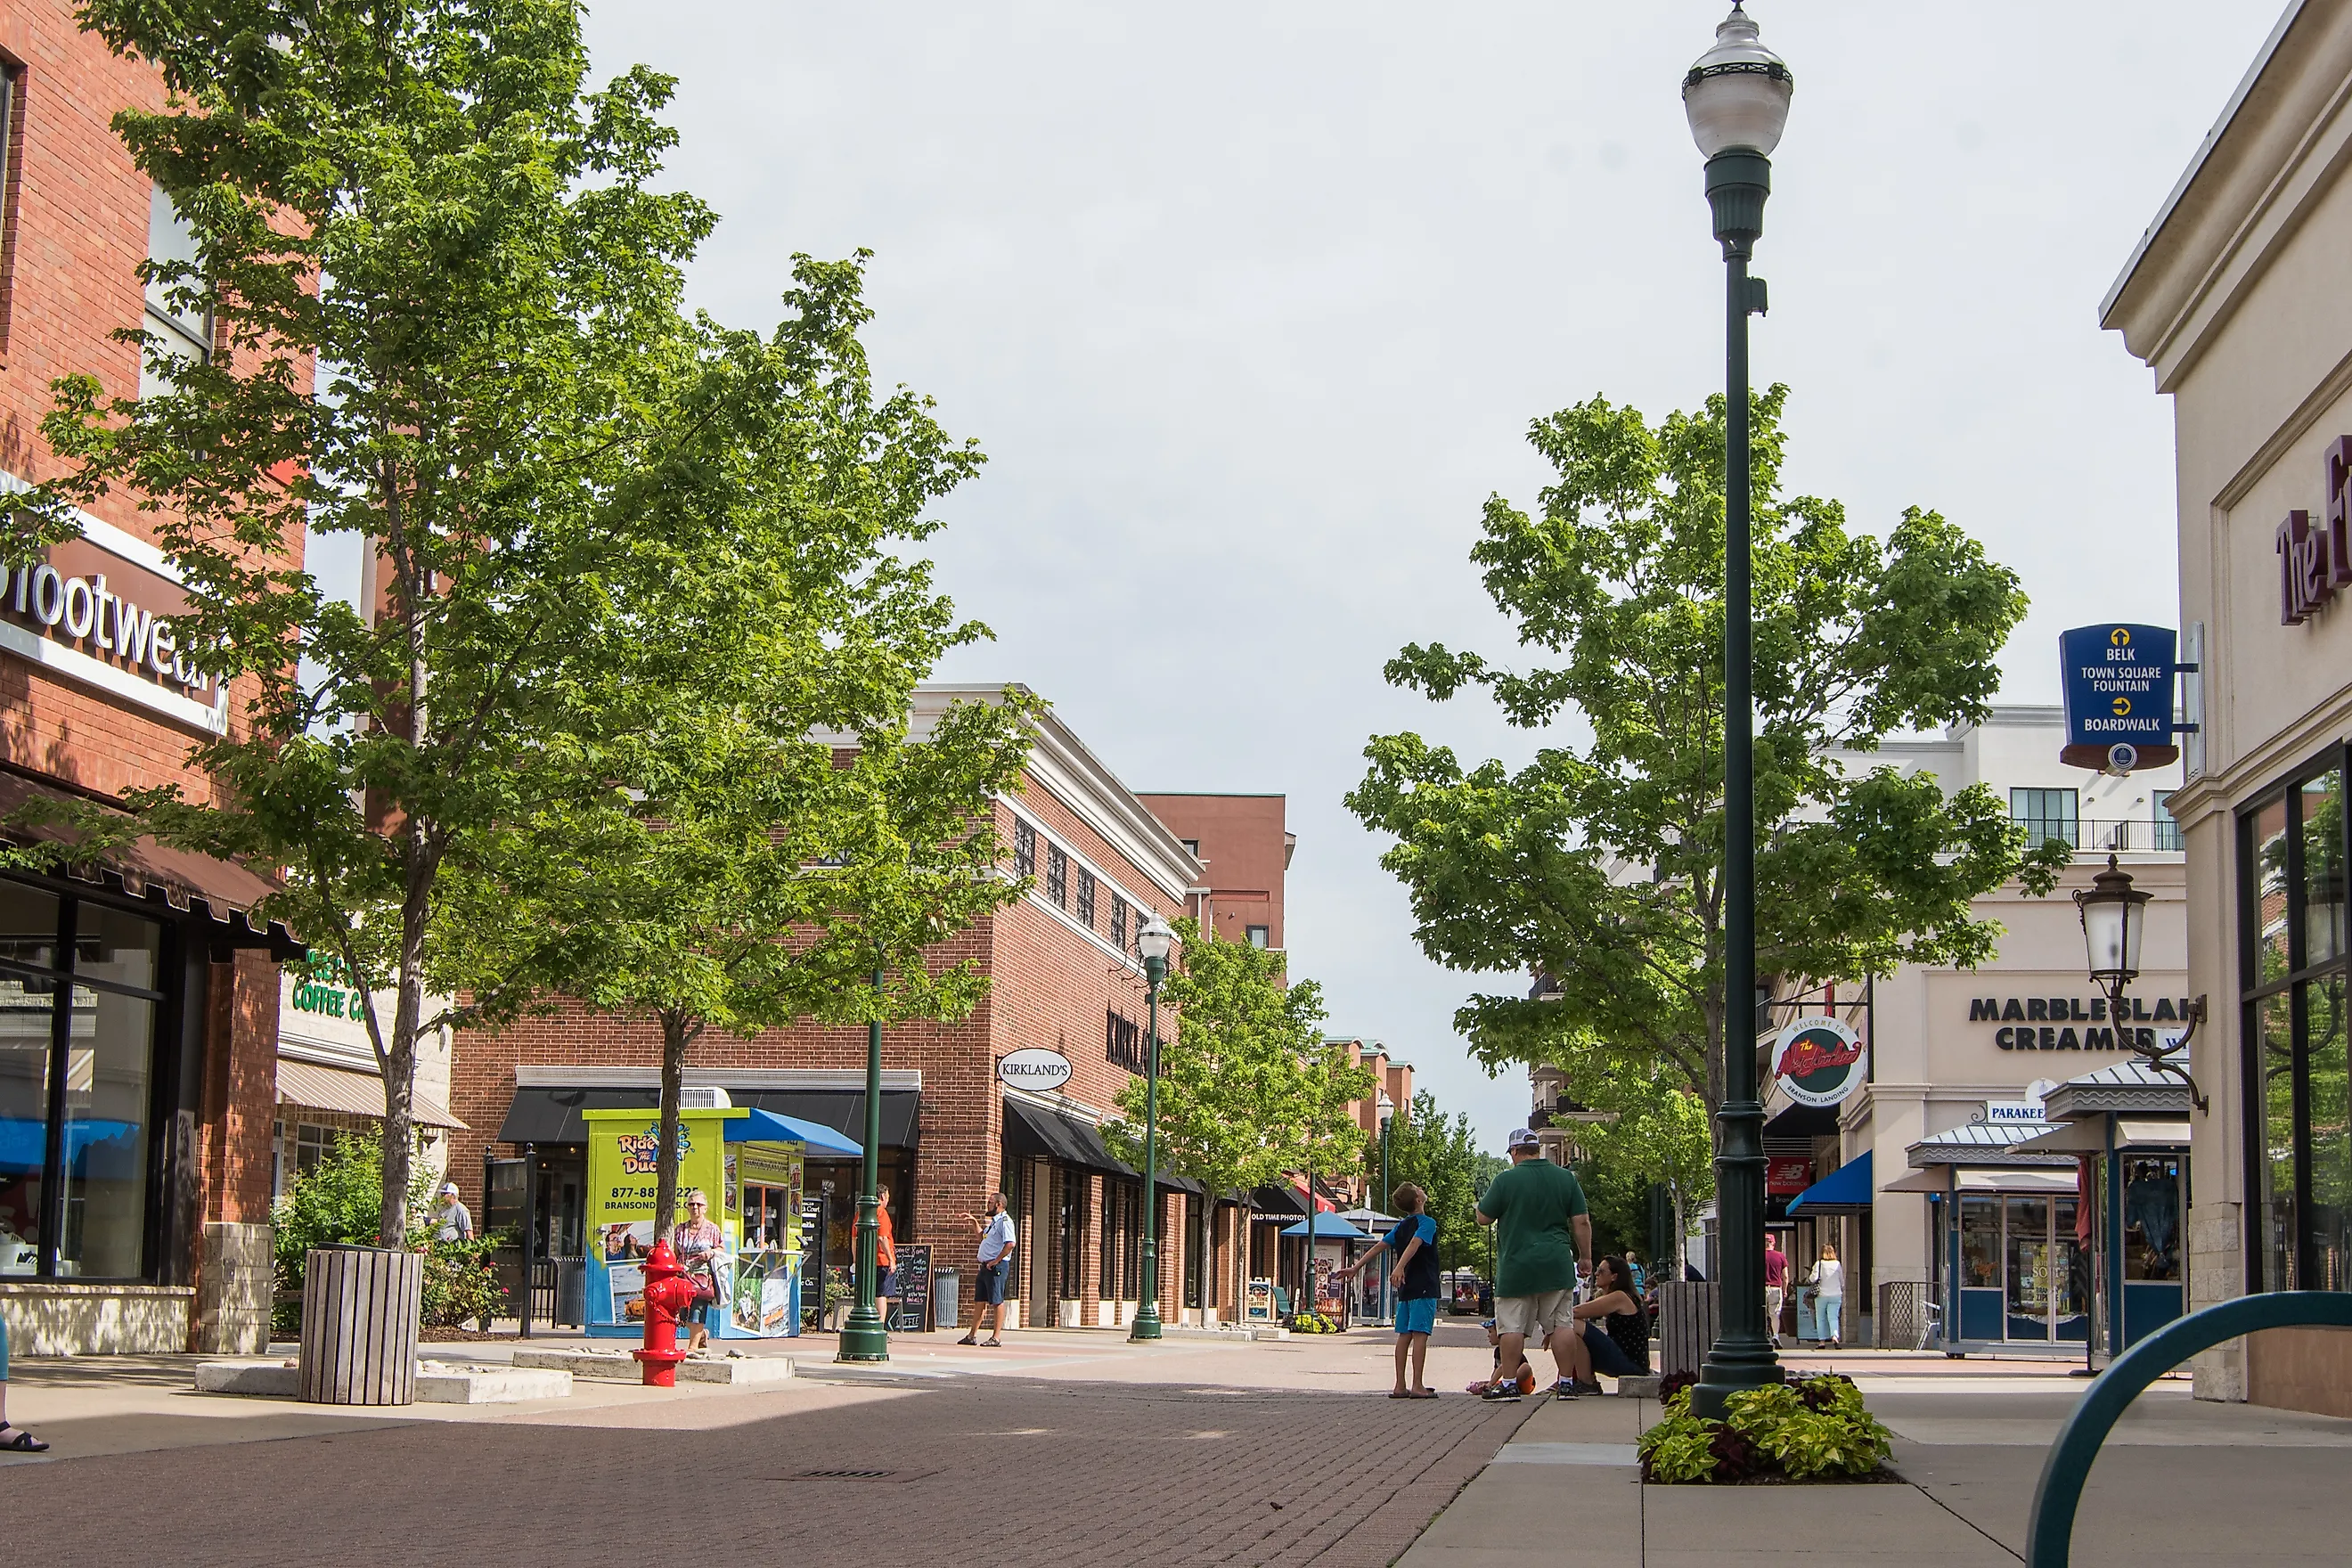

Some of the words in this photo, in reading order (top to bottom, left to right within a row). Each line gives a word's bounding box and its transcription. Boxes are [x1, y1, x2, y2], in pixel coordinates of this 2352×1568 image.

[2276, 510, 2325, 625] The
[2324, 435, 2352, 589] F
[15, 561, 208, 691] ootwea
[2106, 649, 2136, 661] BELK
[2081, 667, 2115, 679] TOWN
[2119, 667, 2161, 679] SQUARE
[2094, 681, 2150, 692] FOUNTAIN
[2085, 719, 2160, 731] BOARDWALK
[294, 981, 345, 1017] COFFEE
[1969, 998, 2106, 1021] MARBLE
[1793, 1019, 1832, 1033] WELCOME
[1835, 1025, 1845, 1033] TO
[1800, 1040, 1813, 1051] The
[1996, 1027, 2154, 1050] CREAMER
[1002, 1064, 1068, 1076] KIRKLAND'S
[1787, 1085, 1817, 1103] BRANSON
[1820, 1086, 1850, 1103] LANDING
[1992, 1107, 2046, 1119] PARAKEE
[618, 1135, 656, 1154] Ride
[623, 1156, 663, 1174] Duc
[896, 1317, 919, 1326] CFFEE
